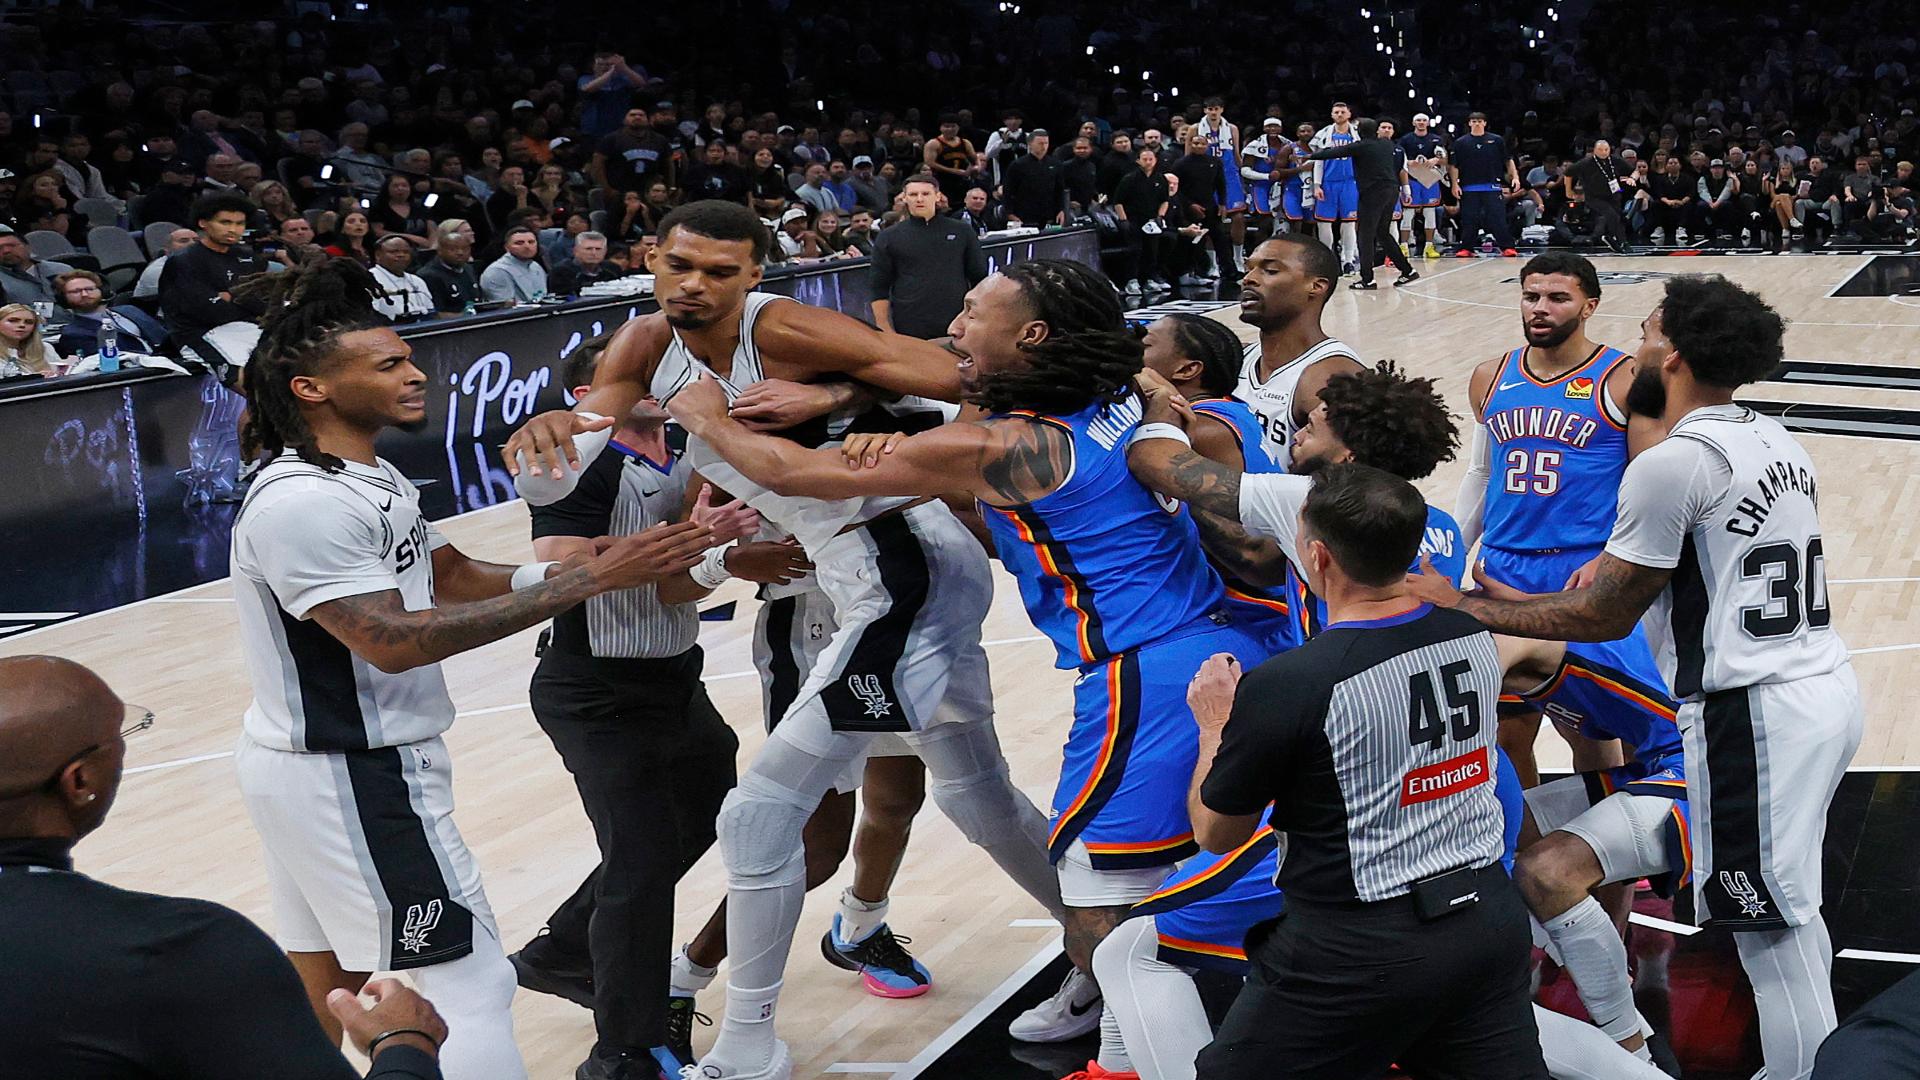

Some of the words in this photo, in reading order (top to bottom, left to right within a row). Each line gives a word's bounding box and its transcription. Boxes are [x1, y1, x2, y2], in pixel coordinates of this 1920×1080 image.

[1086, 391, 1143, 452] WILLIAM
[1486, 406, 1599, 449] THUNDER
[1505, 448, 1561, 496] 25
[1739, 535, 1831, 641] 30
[1408, 659, 1481, 750] 45
[1408, 760, 1482, 796] Emirates
